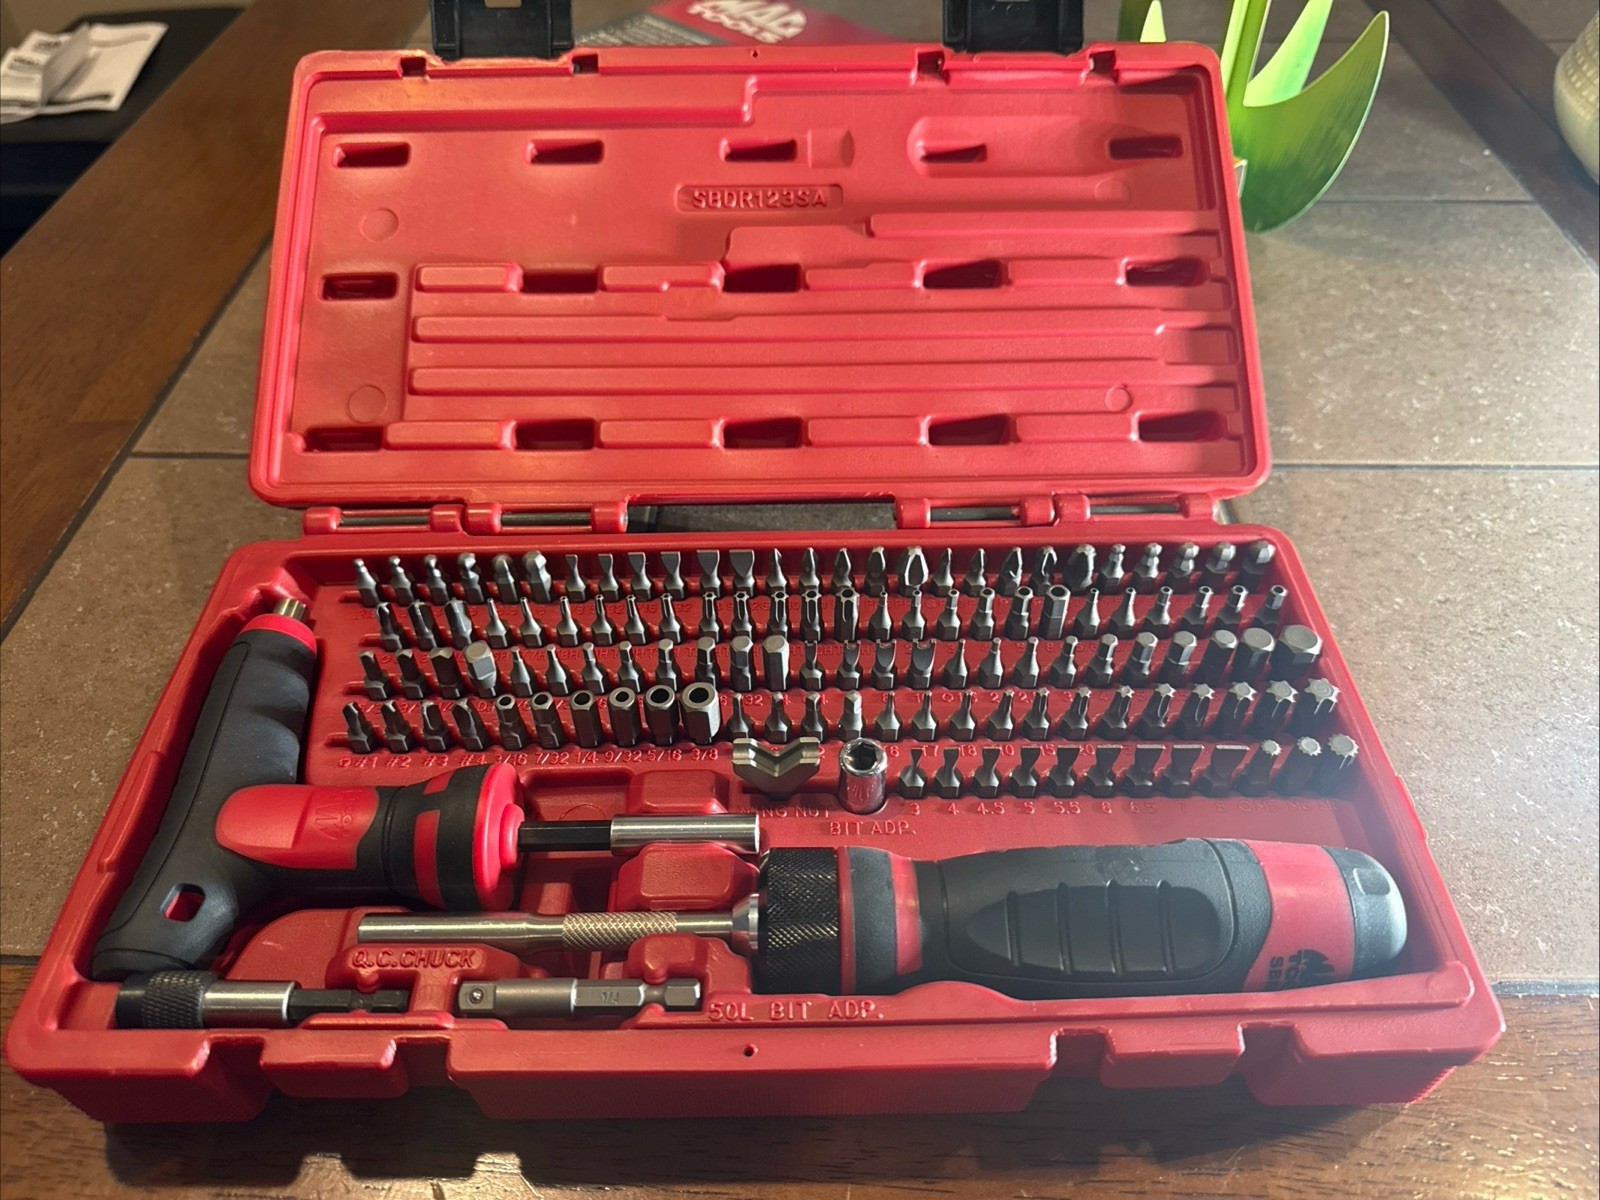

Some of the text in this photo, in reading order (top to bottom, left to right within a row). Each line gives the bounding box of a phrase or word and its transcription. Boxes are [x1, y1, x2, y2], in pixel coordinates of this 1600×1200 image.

[692, 188, 827, 209] SBDR123SA
[355, 756, 378, 769] #1
[386, 755, 412, 769] #2
[423, 754, 449, 767] #3
[536, 752, 571, 766] 7/32
[577, 750, 599, 764] 1/4
[604, 750, 643, 764] 9/32
[646, 748, 683, 763] 5/16
[692, 748, 719, 761] 3/8
[795, 804, 829, 818] NUT
[910, 802, 921, 816] 3
[947, 801, 960, 815] 4
[976, 801, 1006, 815] 4.5
[1023, 800, 1036, 815] 5
[1053, 800, 1082, 815] 5.5
[1100, 800, 1113, 814] 6
[1129, 800, 1156, 814] 6.5
[829, 820, 917, 836] BIT ADP.
[352, 949, 476, 969] Q.C.CHUCK
[770, 1000, 813, 1020] BIT
[827, 999, 885, 1020] ADP.
